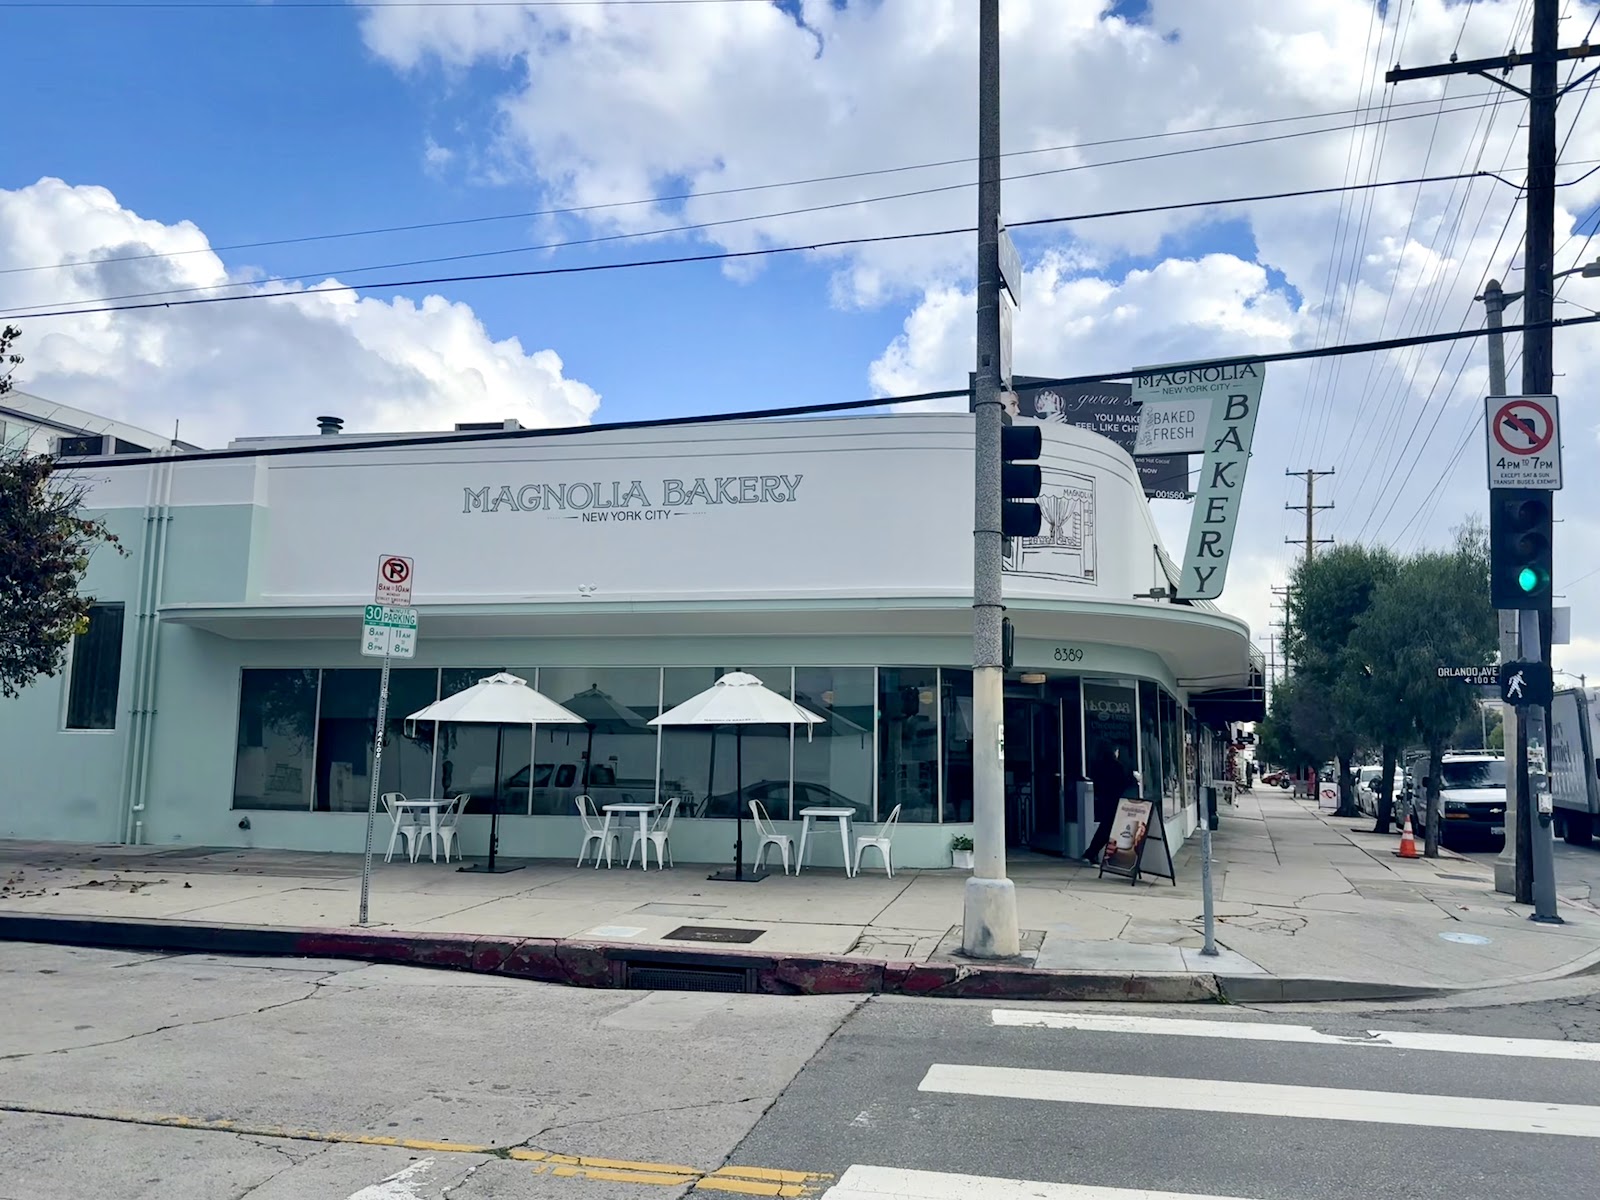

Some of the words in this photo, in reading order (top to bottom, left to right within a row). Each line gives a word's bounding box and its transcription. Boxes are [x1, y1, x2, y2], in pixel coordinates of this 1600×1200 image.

[1137, 364, 1258, 388] MAGNOLIA
[1162, 387, 1182, 395] NEW
[1184, 385, 1208, 393] YORK
[1210, 383, 1231, 392] CITY
[1094, 413, 1114, 422] YOU
[1153, 410, 1195, 425] BAKED
[1099, 423, 1120, 432] LIKE
[1153, 426, 1194, 441] FRESH
[1496, 457, 1520, 469] 4PM
[1530, 457, 1553, 469] 7PM
[462, 480, 652, 513] MAGNOLIA
[662, 474, 804, 506] BAKERY
[1155, 490, 1185, 499] 001560
[1193, 394, 1249, 593] BAKERY
[582, 512, 608, 522] NEW
[610, 511, 642, 522] YORK
[644, 510, 671, 521] CITY
[366, 606, 382, 620] 30
[383, 612, 415, 625] PARKING
[1054, 648, 1083, 662] 8389
[1437, 667, 1479, 677] ORLANDO
[1481, 667, 1499, 676] AVE
[1473, 676, 1489, 684] 100
